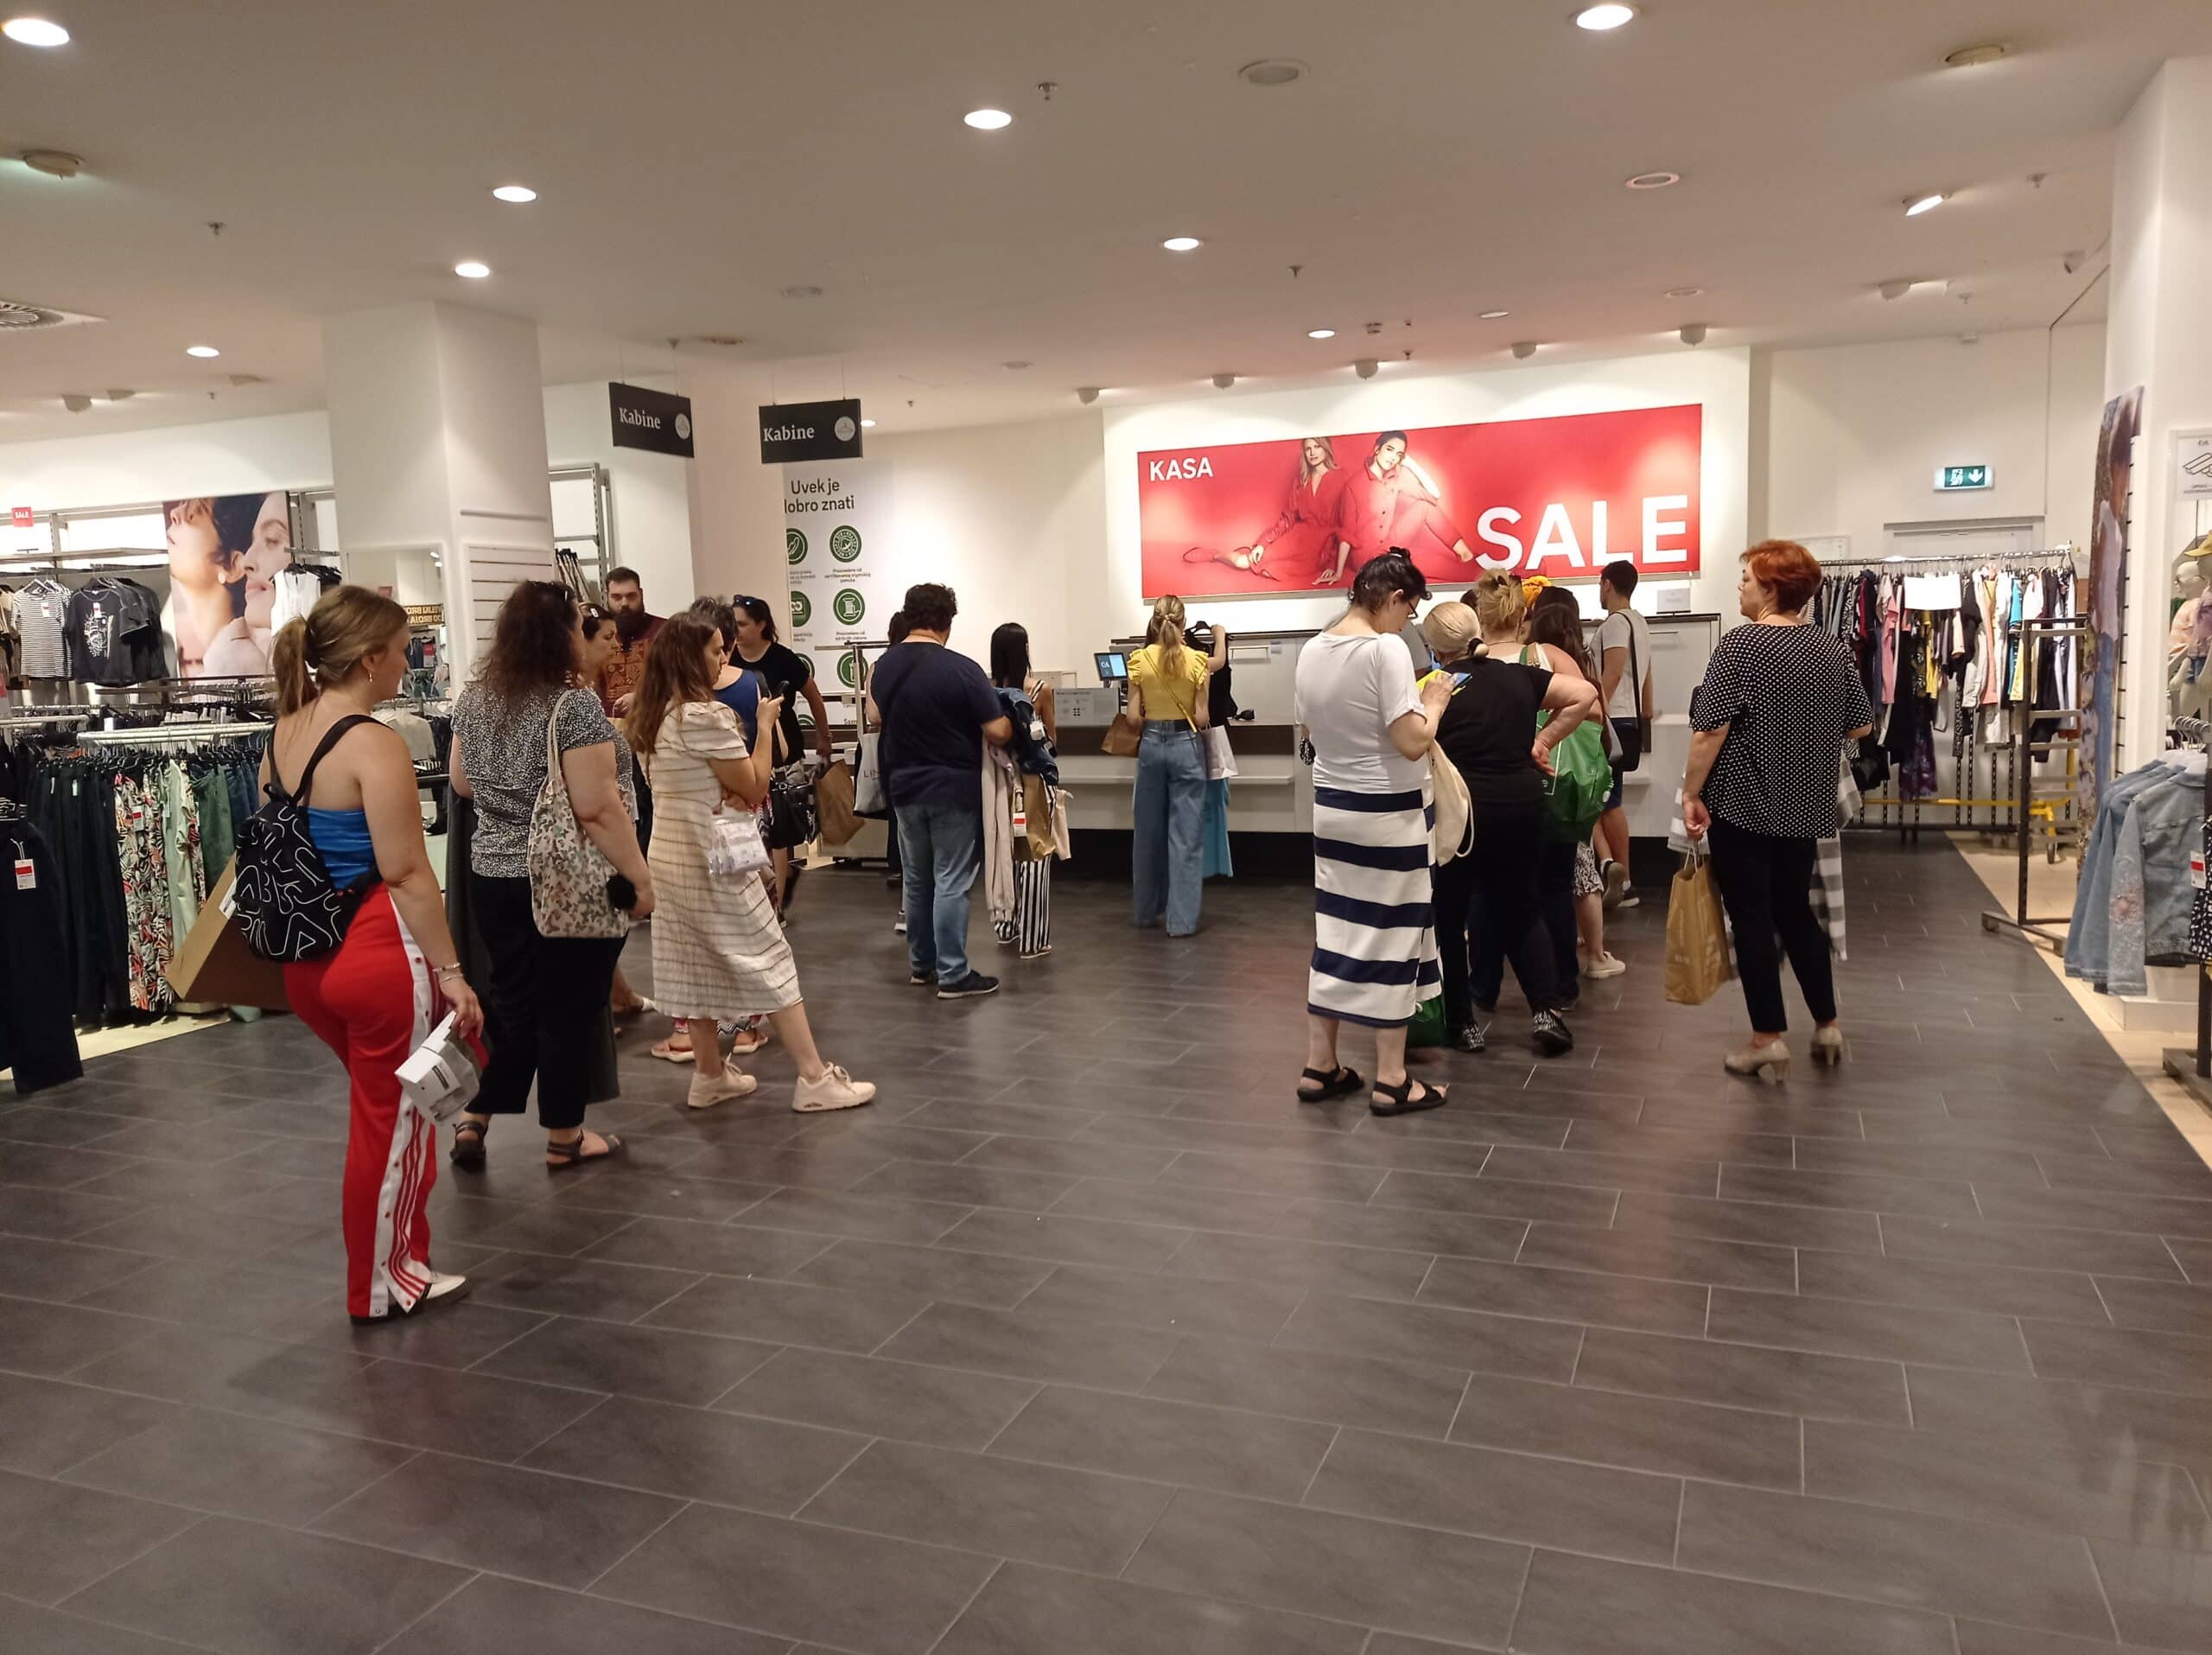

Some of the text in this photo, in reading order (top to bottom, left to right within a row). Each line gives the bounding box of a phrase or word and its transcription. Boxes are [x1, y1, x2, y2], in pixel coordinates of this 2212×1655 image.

[619, 407, 661, 430] Kabine
[763, 424, 815, 442] Kabine
[1149, 456, 1213, 481] KASA
[791, 478, 840, 495] Uvek je
[822, 495, 855, 512] znati
[1476, 494, 1688, 570] SALE
